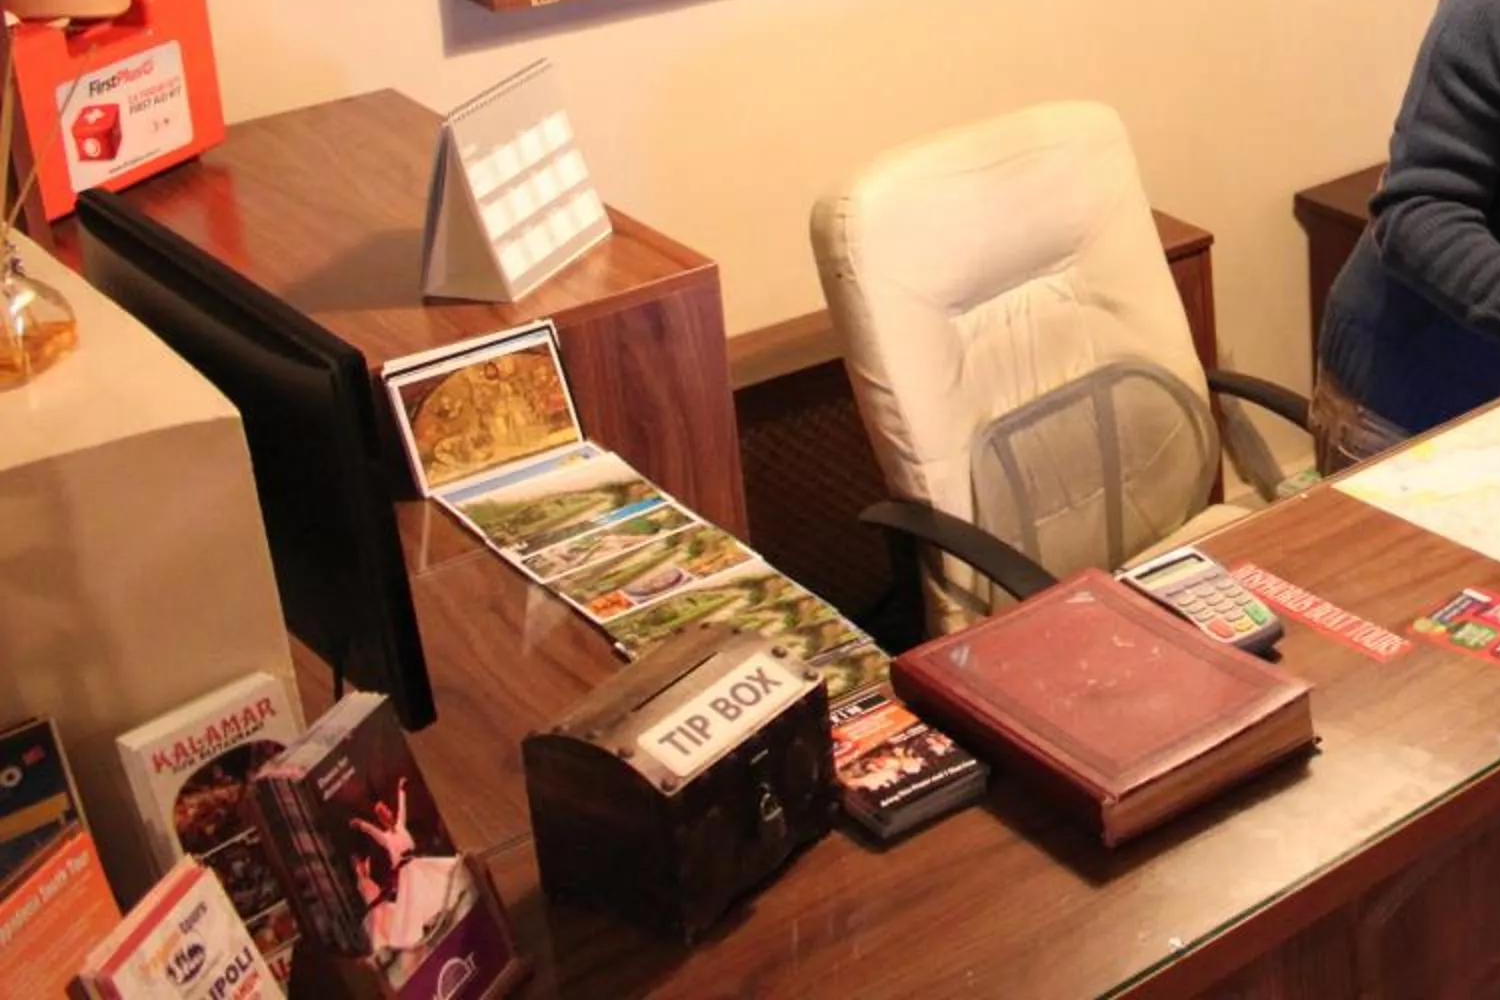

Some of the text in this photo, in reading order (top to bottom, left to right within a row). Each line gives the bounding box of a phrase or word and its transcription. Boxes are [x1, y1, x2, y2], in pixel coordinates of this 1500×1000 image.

[1344, 617, 1410, 655] TOURS
[151, 697, 277, 775] KALAMAR
[657, 711, 714, 757] TIP
[707, 666, 784, 723] BOX
[202, 946, 254, 1000] IPOLI
